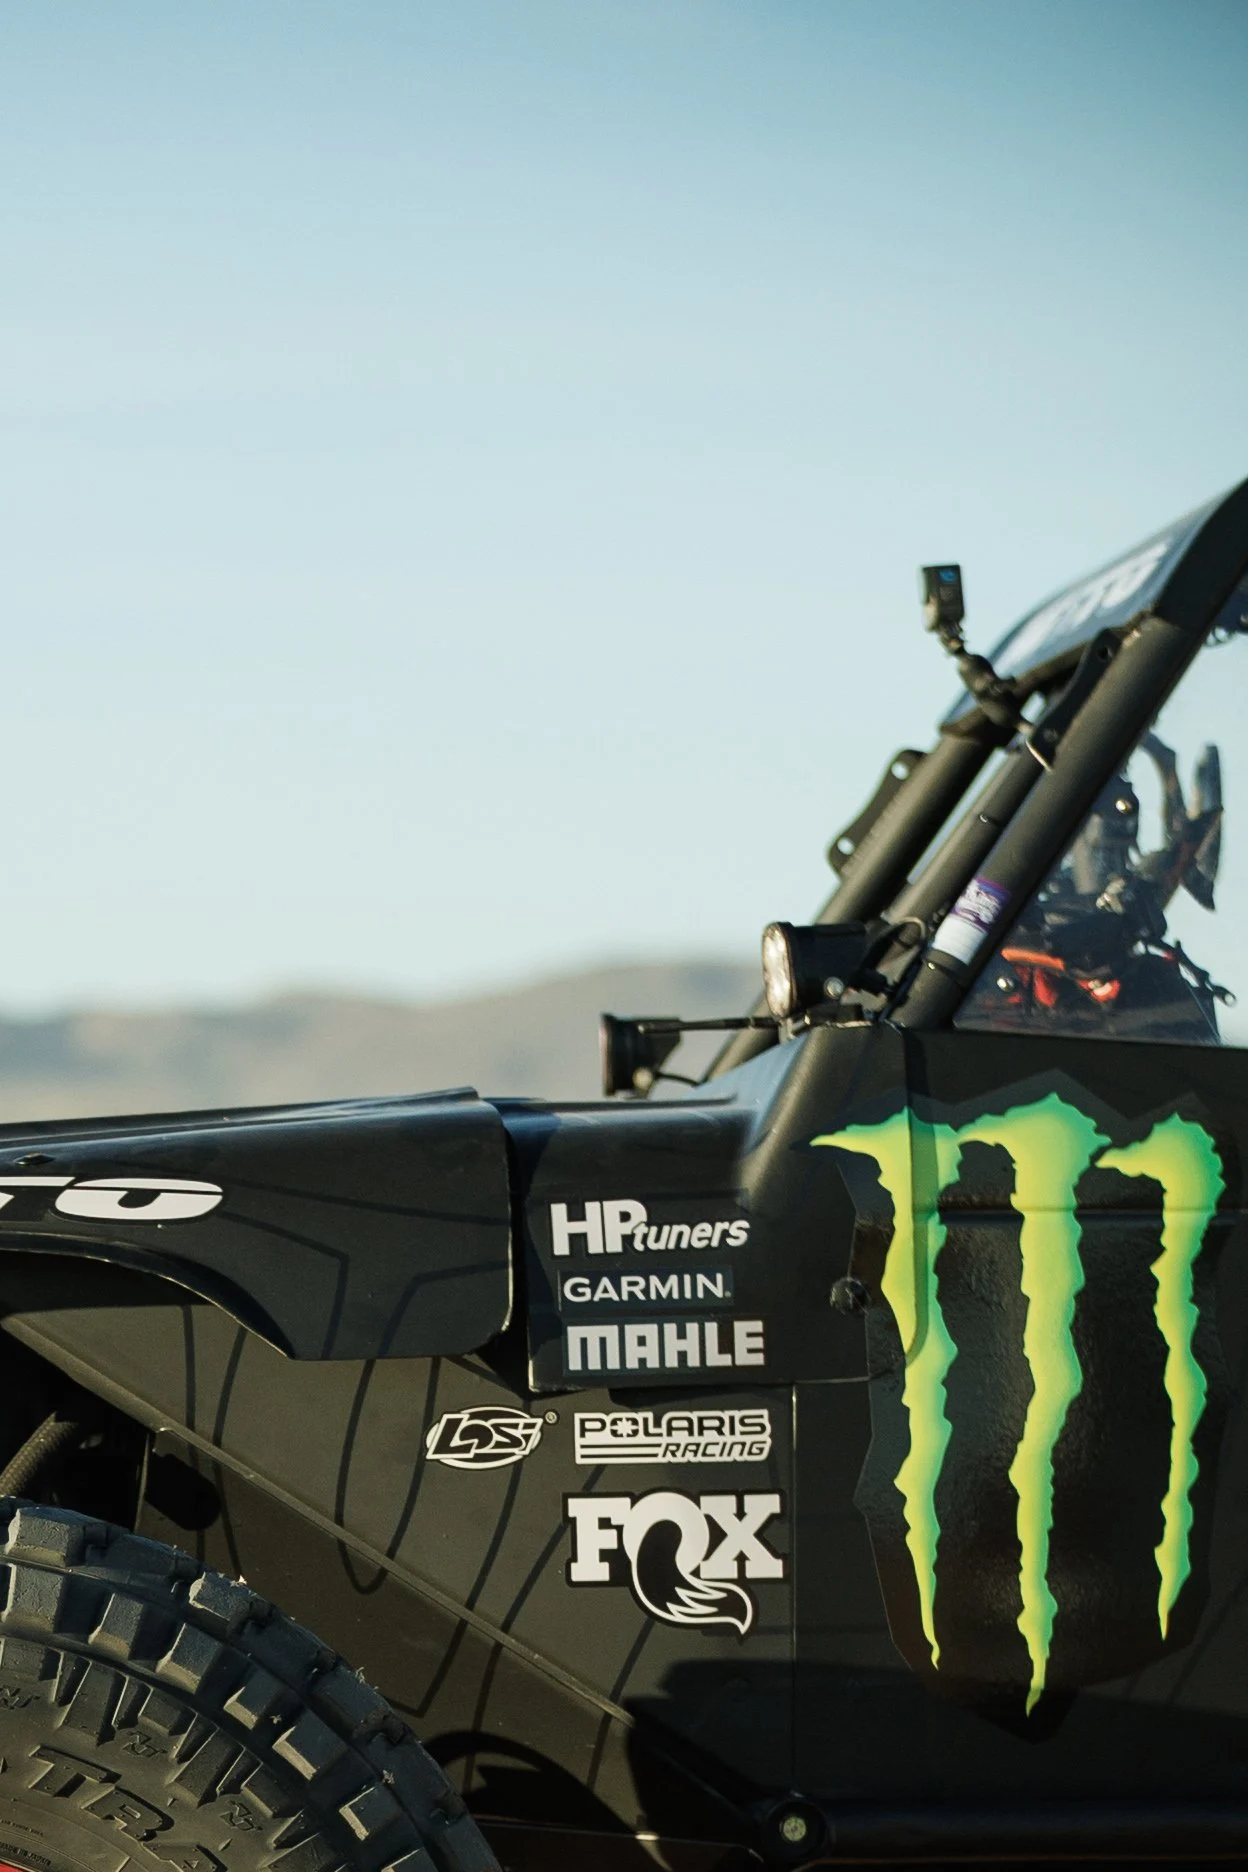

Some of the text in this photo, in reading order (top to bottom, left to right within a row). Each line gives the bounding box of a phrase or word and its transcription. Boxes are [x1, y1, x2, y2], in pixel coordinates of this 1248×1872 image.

[563, 1273, 724, 1303] GARMIN
[567, 1320, 765, 1371] MAHLE
[578, 1413, 768, 1439] POLARIS
[661, 1441, 766, 1459] RACING
[567, 1491, 784, 1634] FOX
